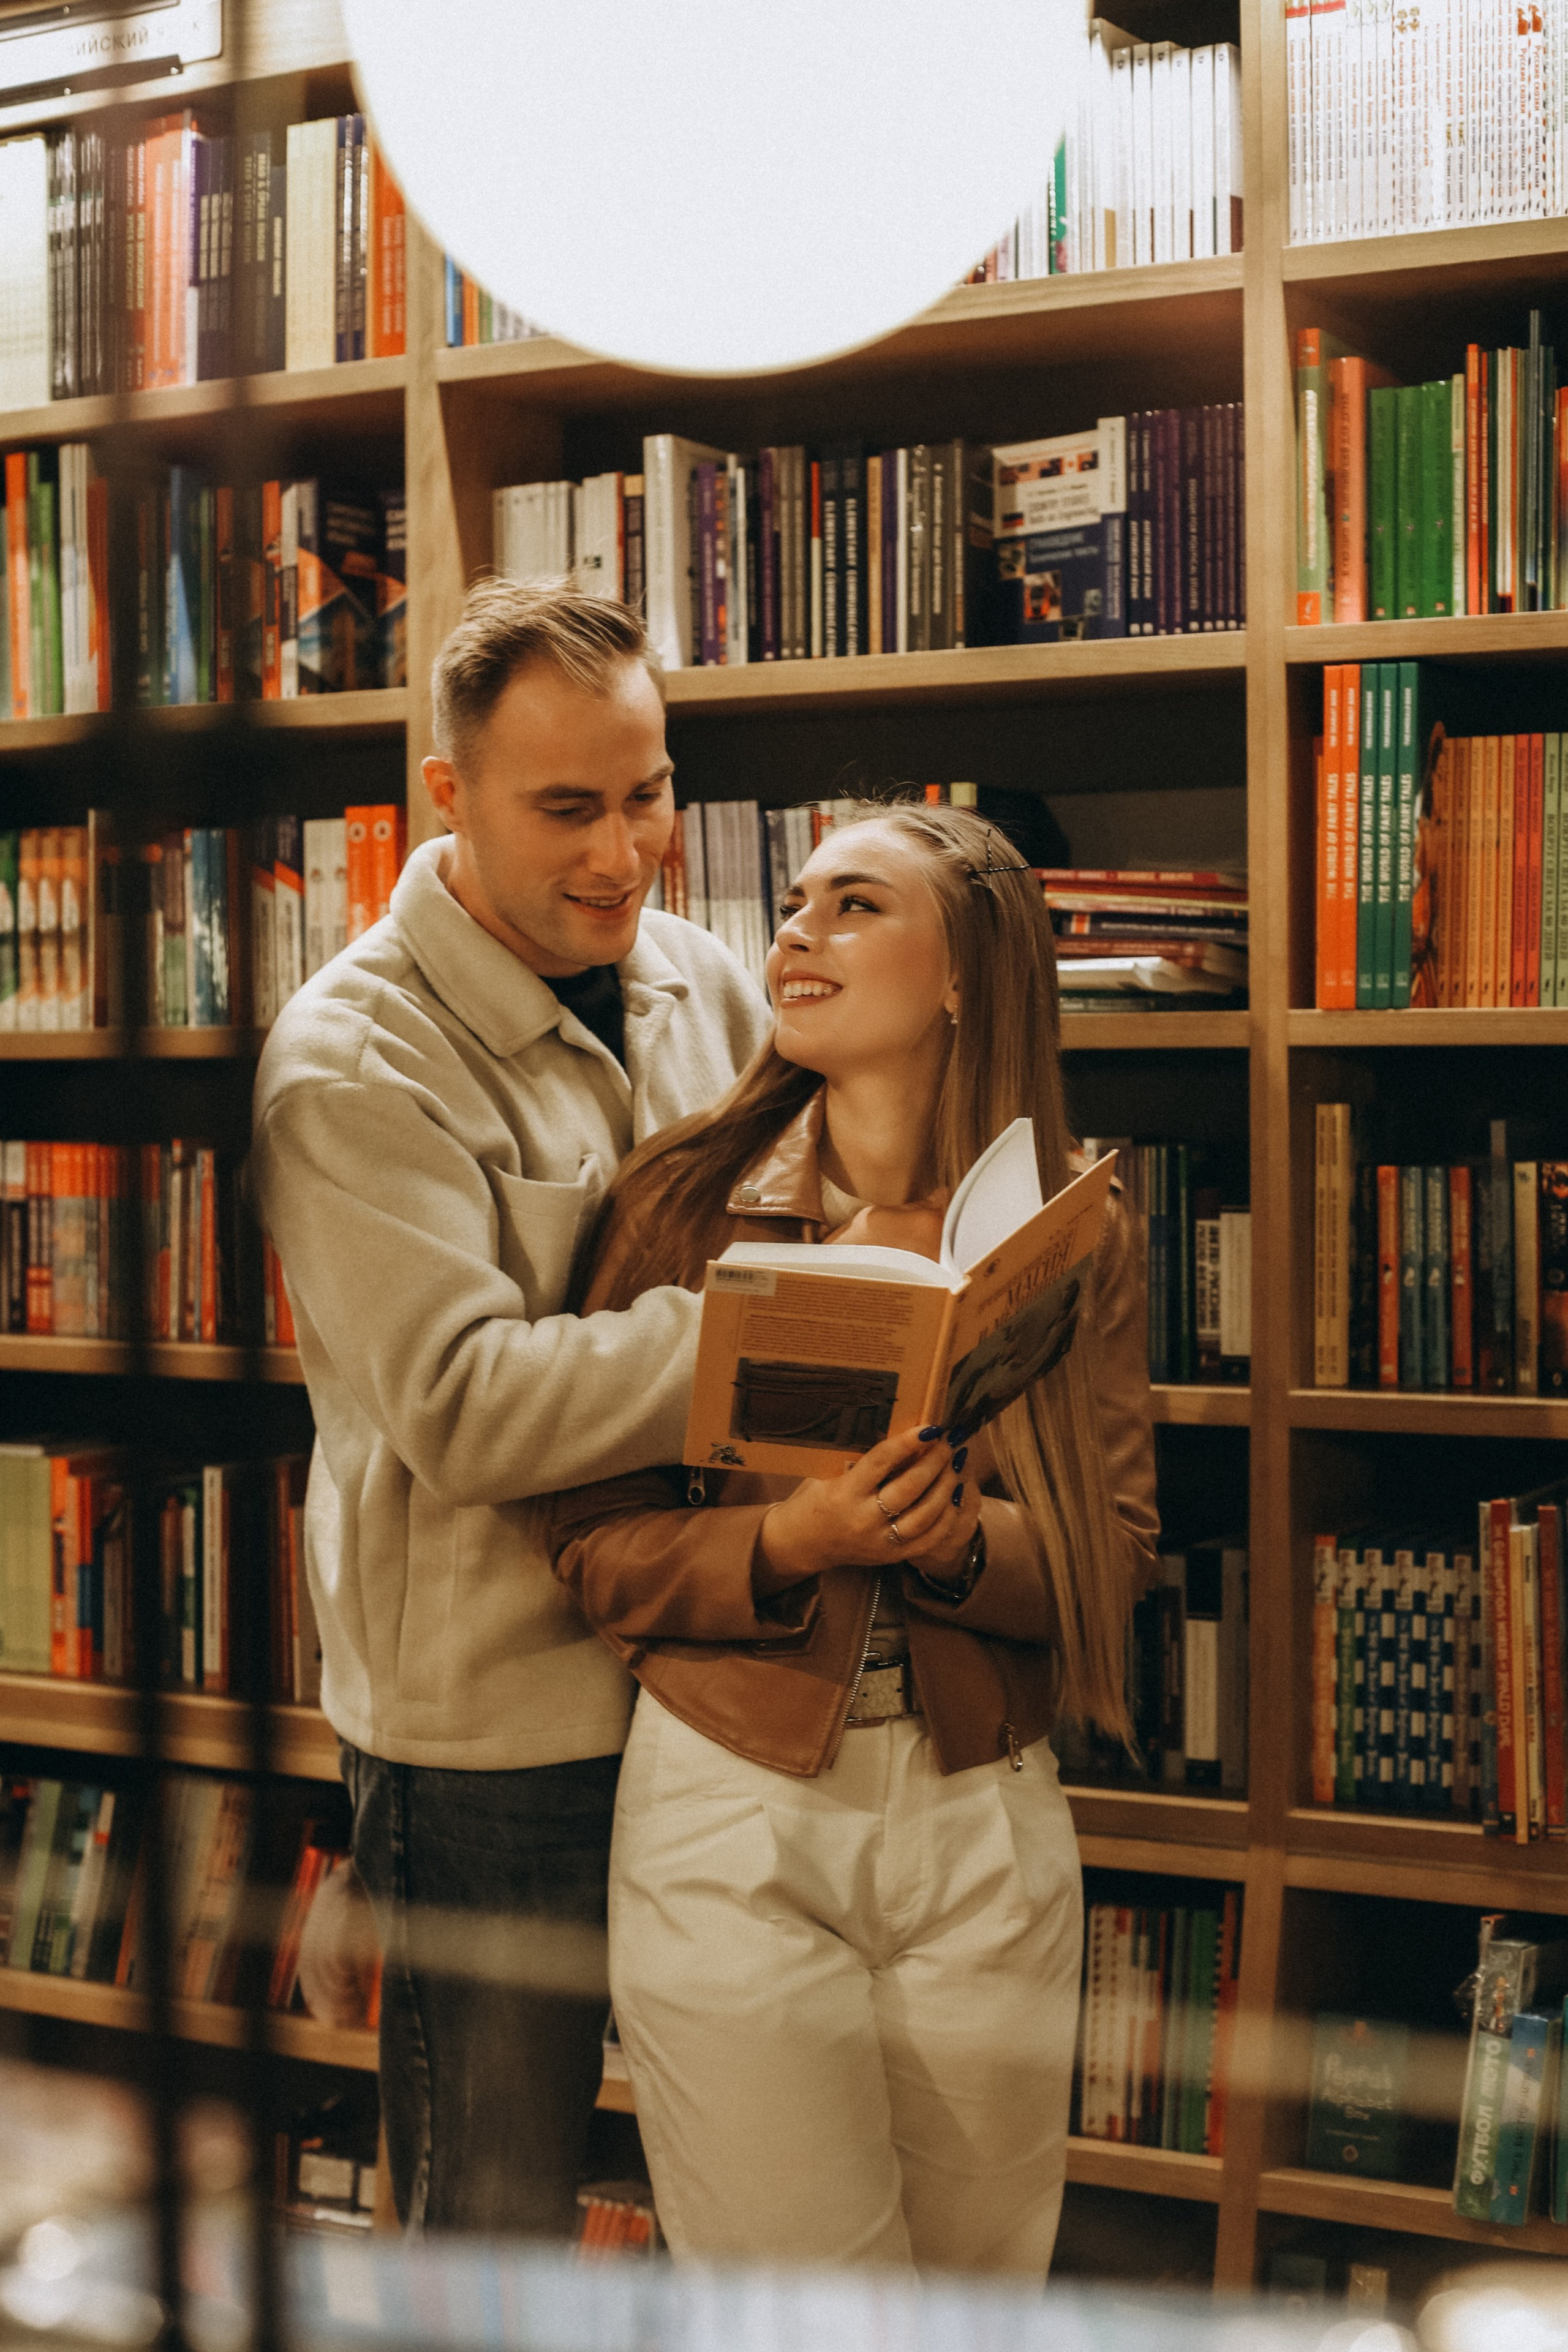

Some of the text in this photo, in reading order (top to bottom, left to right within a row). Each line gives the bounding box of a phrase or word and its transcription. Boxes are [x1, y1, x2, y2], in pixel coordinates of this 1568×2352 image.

[1519, 48, 1528, 82] Русские
[1533, 46, 1542, 80] Русские
[1534, 116, 1539, 125] на
[1189, 516, 1198, 533] FOR
[1189, 534, 1198, 575] POLITICAL
[824, 500, 837, 657] ELEMENTARY COMMUNICATION
[846, 499, 858, 656] ELEMENTARY COMMUNICATION
[1189, 576, 1198, 610] STUDIES
[1326, 772, 1339, 801] TALES
[1343, 772, 1357, 799] TALES
[1326, 802, 1338, 830] FAIRY
[1343, 801, 1356, 829] FAIRY
[1326, 832, 1338, 845] OF
[1343, 831, 1355, 844] OF
[1361, 774, 1374, 903] THE WORLD OF FAIRY TALES
[1378, 774, 1392, 903] THE WORLD OF FAIRY TALES
[1398, 773, 1412, 902] THE WORLD OF FAIRY TALES
[1326, 846, 1338, 880] WORLD
[1343, 845, 1355, 880] WORLD
[1470, 2040, 1502, 2185] ФУТБОЛ ЛОТО
